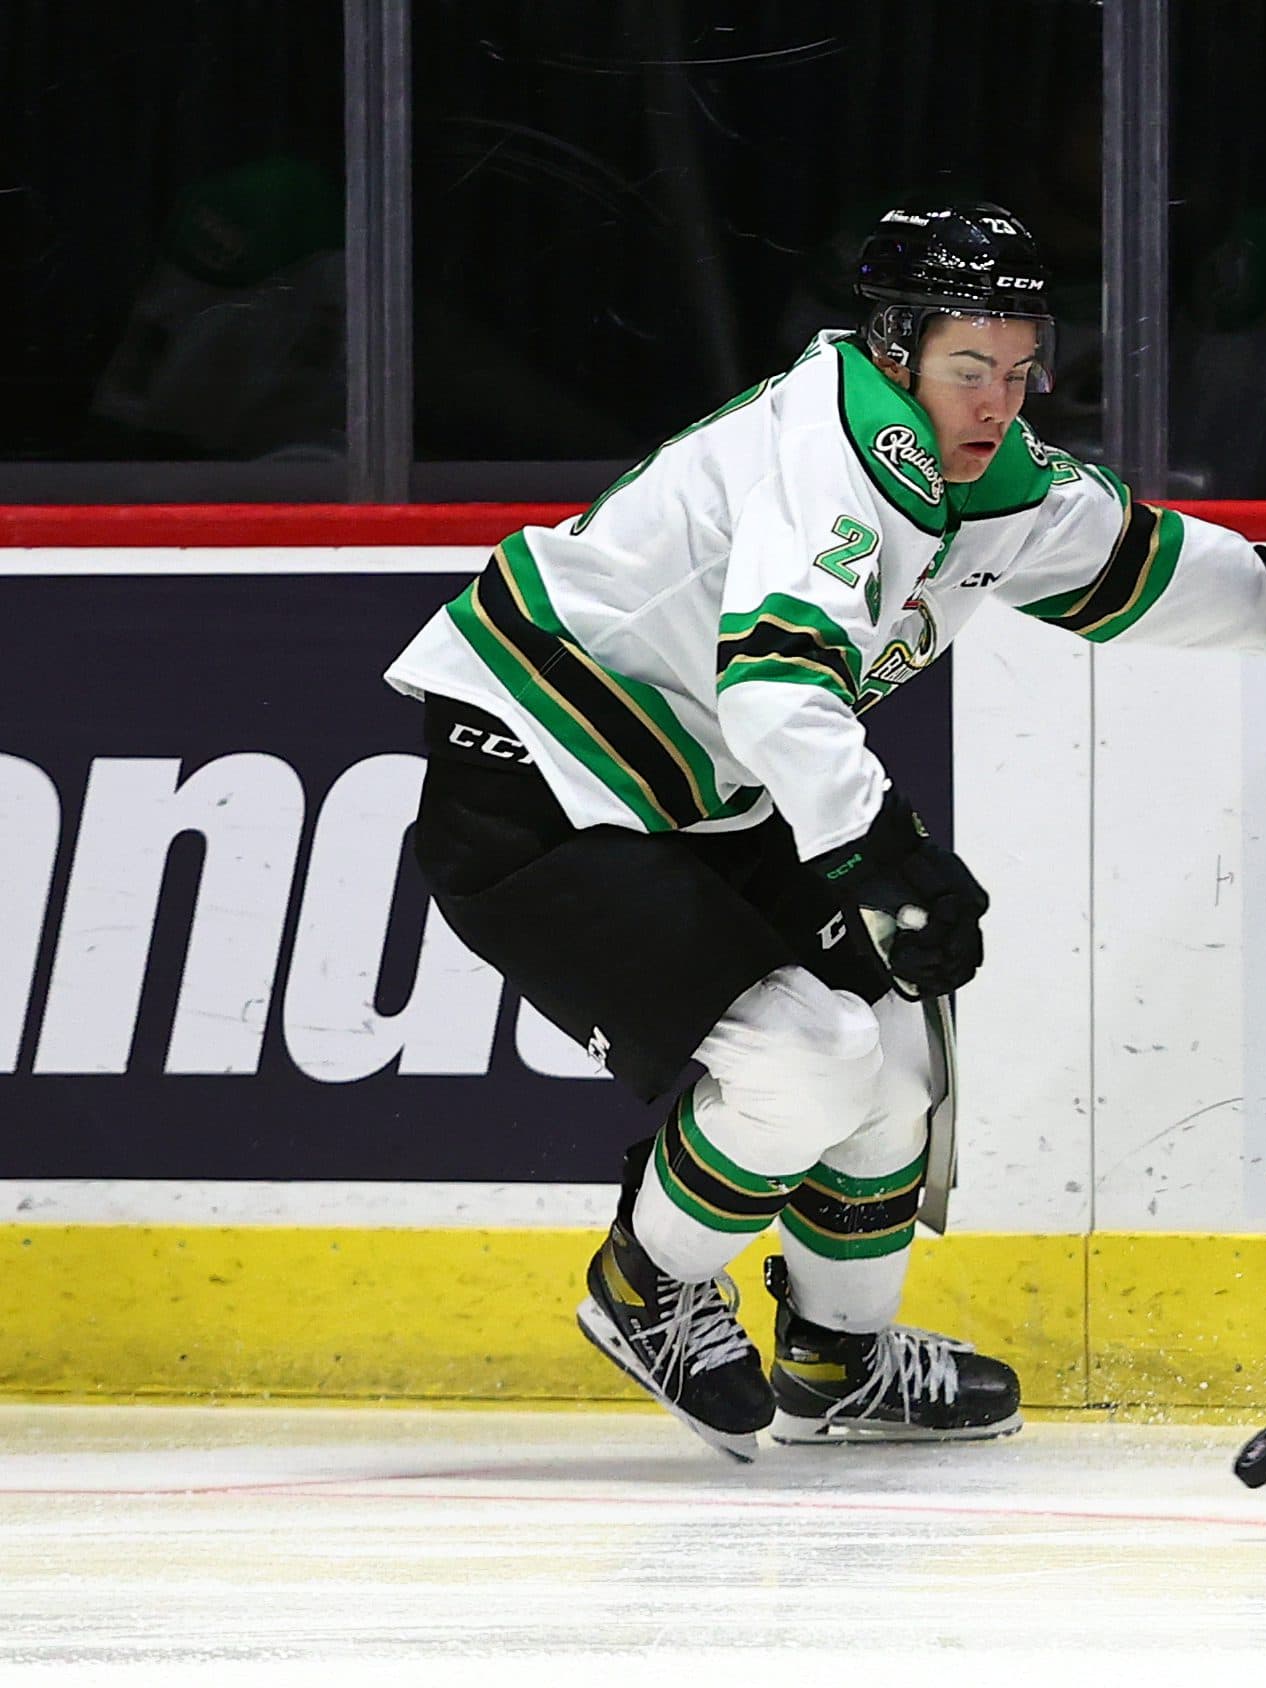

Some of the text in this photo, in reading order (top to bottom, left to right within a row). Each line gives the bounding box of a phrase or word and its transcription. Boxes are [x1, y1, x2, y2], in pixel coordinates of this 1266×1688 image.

[996, 276, 1044, 290] CCM
[952, 572, 1003, 587] CM
[449, 723, 534, 765] CC
